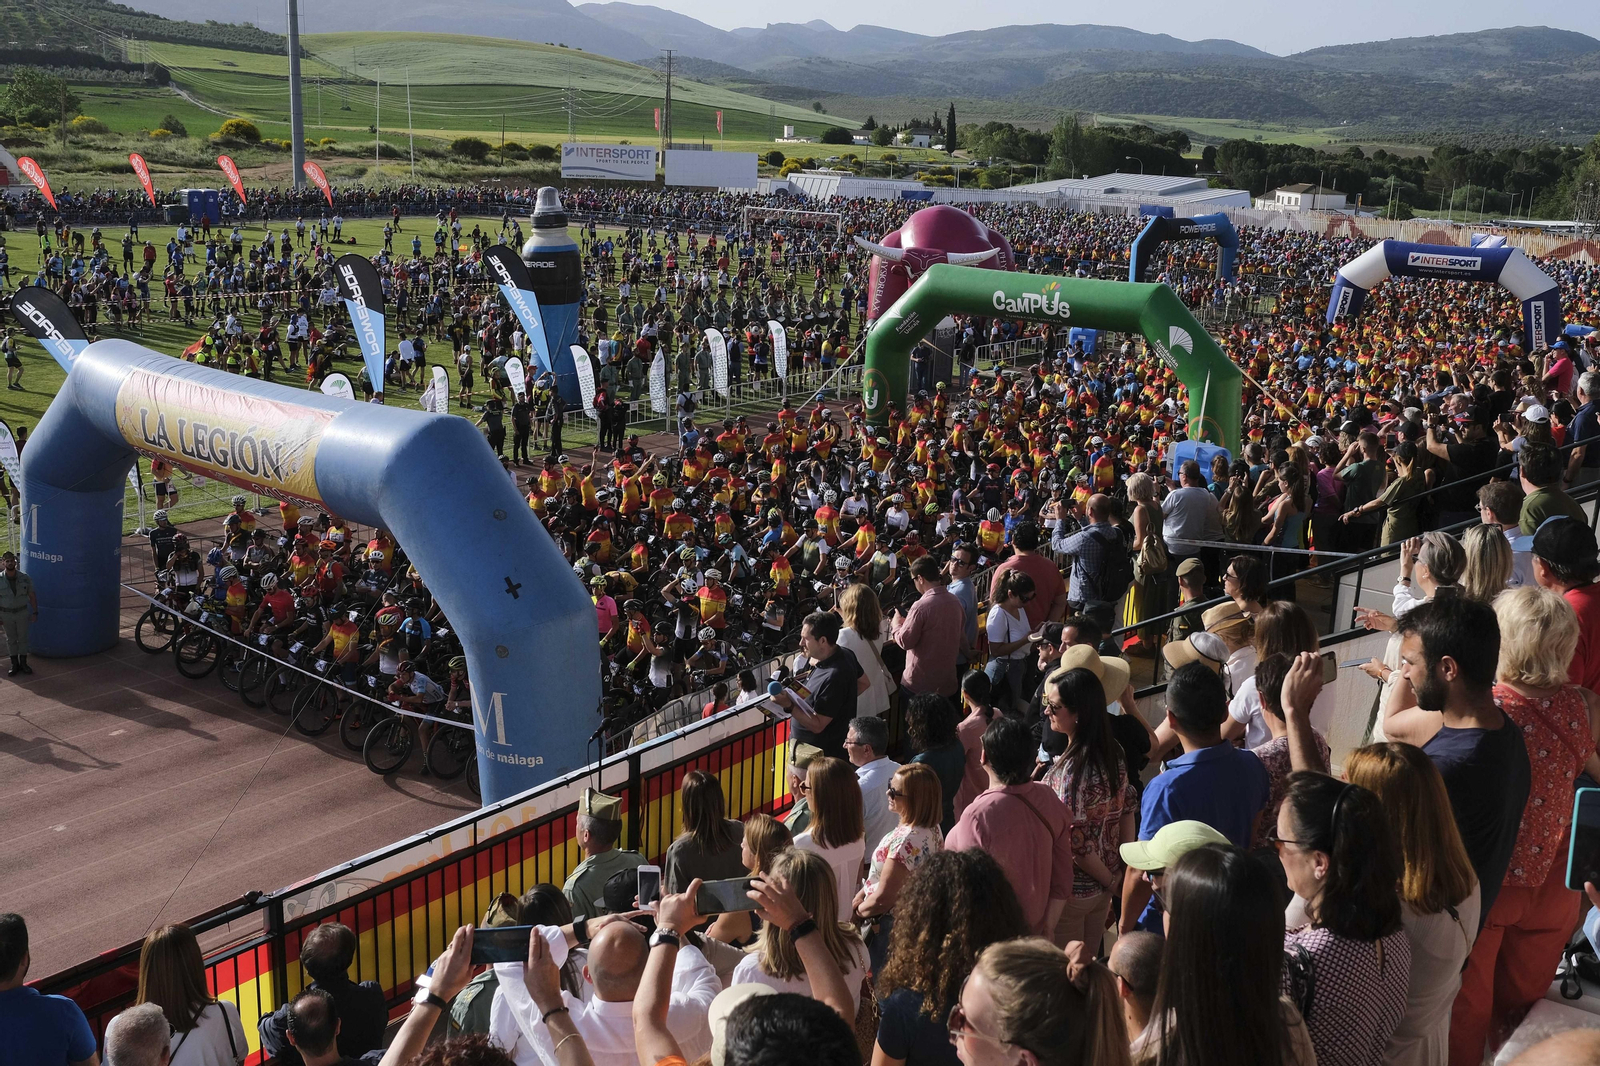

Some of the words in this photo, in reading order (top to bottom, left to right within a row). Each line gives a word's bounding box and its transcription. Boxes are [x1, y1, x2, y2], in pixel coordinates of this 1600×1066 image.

[575, 147, 651, 159] INTERSPORT
[1179, 223, 1217, 234] POWERADE
[1420, 256, 1478, 267] INTERSPORT
[140, 408, 177, 452] LA
[177, 417, 285, 485] LEGIÓN
[30, 551, 64, 564] málaga
[485, 747, 495, 760] de
[496, 753, 545, 768] málaga
